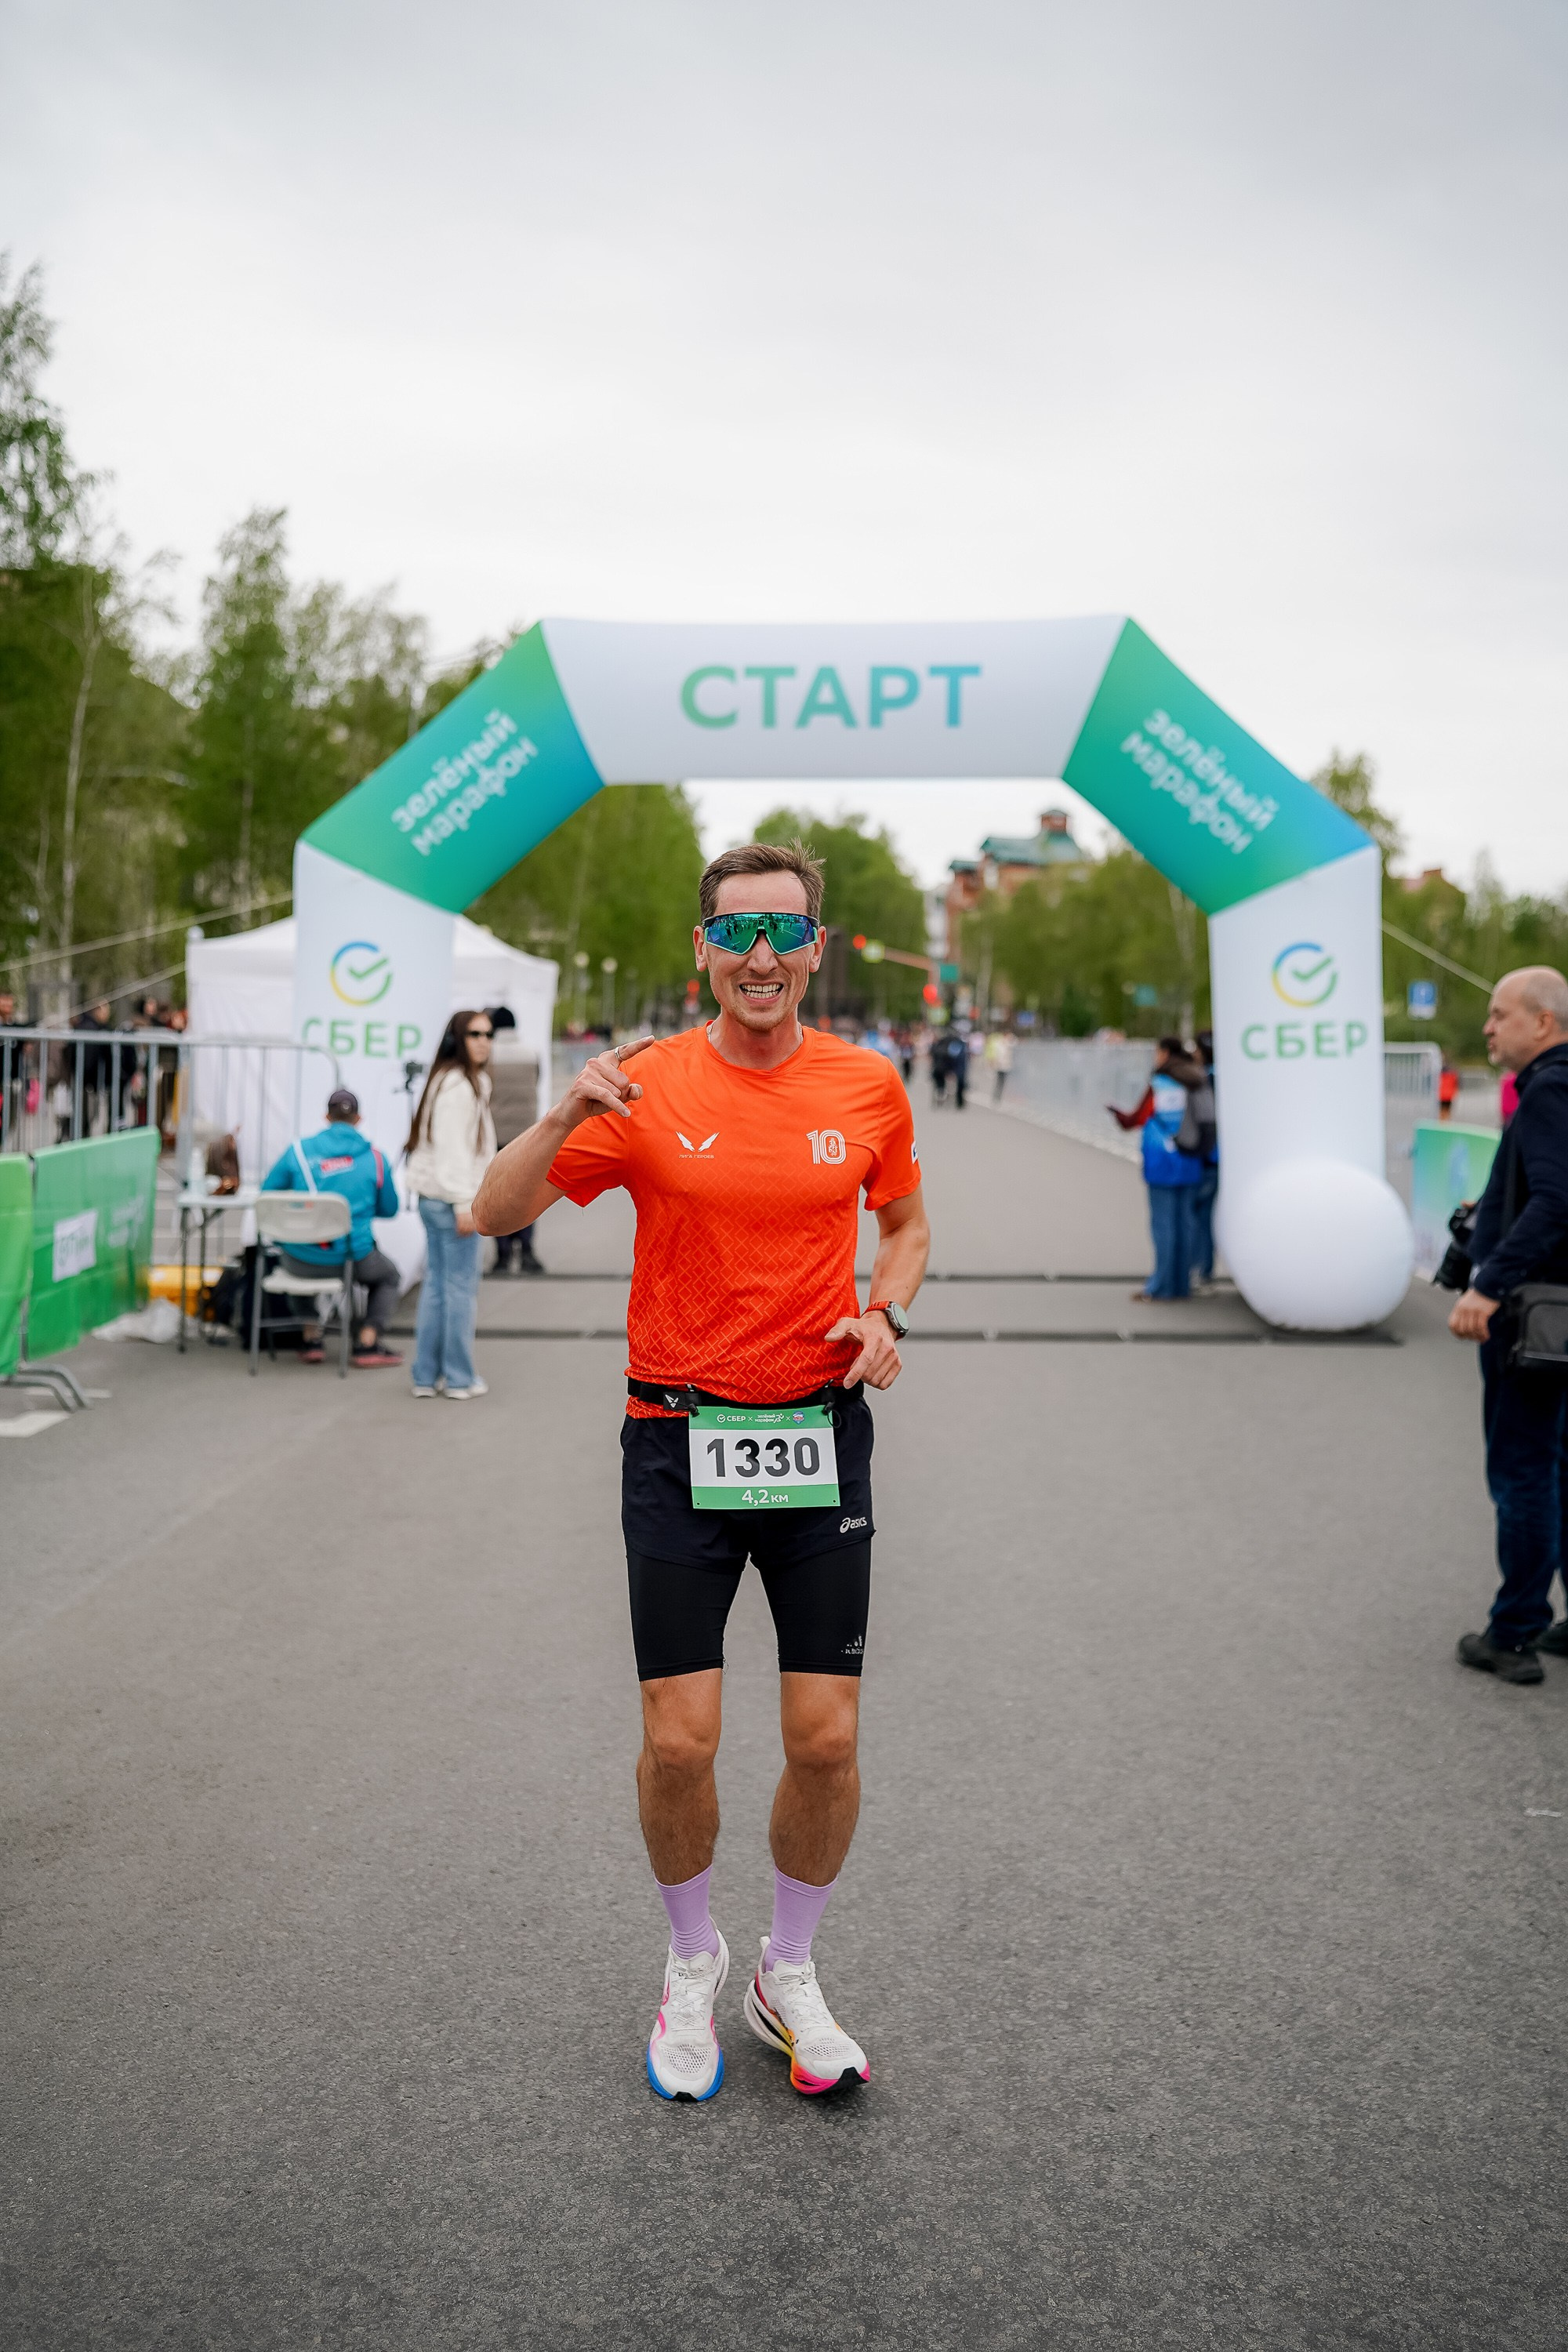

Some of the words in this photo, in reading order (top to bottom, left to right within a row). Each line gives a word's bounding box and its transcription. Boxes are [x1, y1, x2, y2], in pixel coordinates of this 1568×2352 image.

[681, 665, 981, 729] СТАРТ
[392, 708, 517, 832] зелёный
[410, 736, 538, 856] марафон
[1120, 731, 1253, 854] марафон
[1143, 709, 1279, 831] зелёный
[1240, 1022, 1367, 1060] СБЕР
[806, 1129, 846, 1164] 10
[706, 1436, 820, 1477] 1330
[742, 1490, 769, 1506] 4,2
